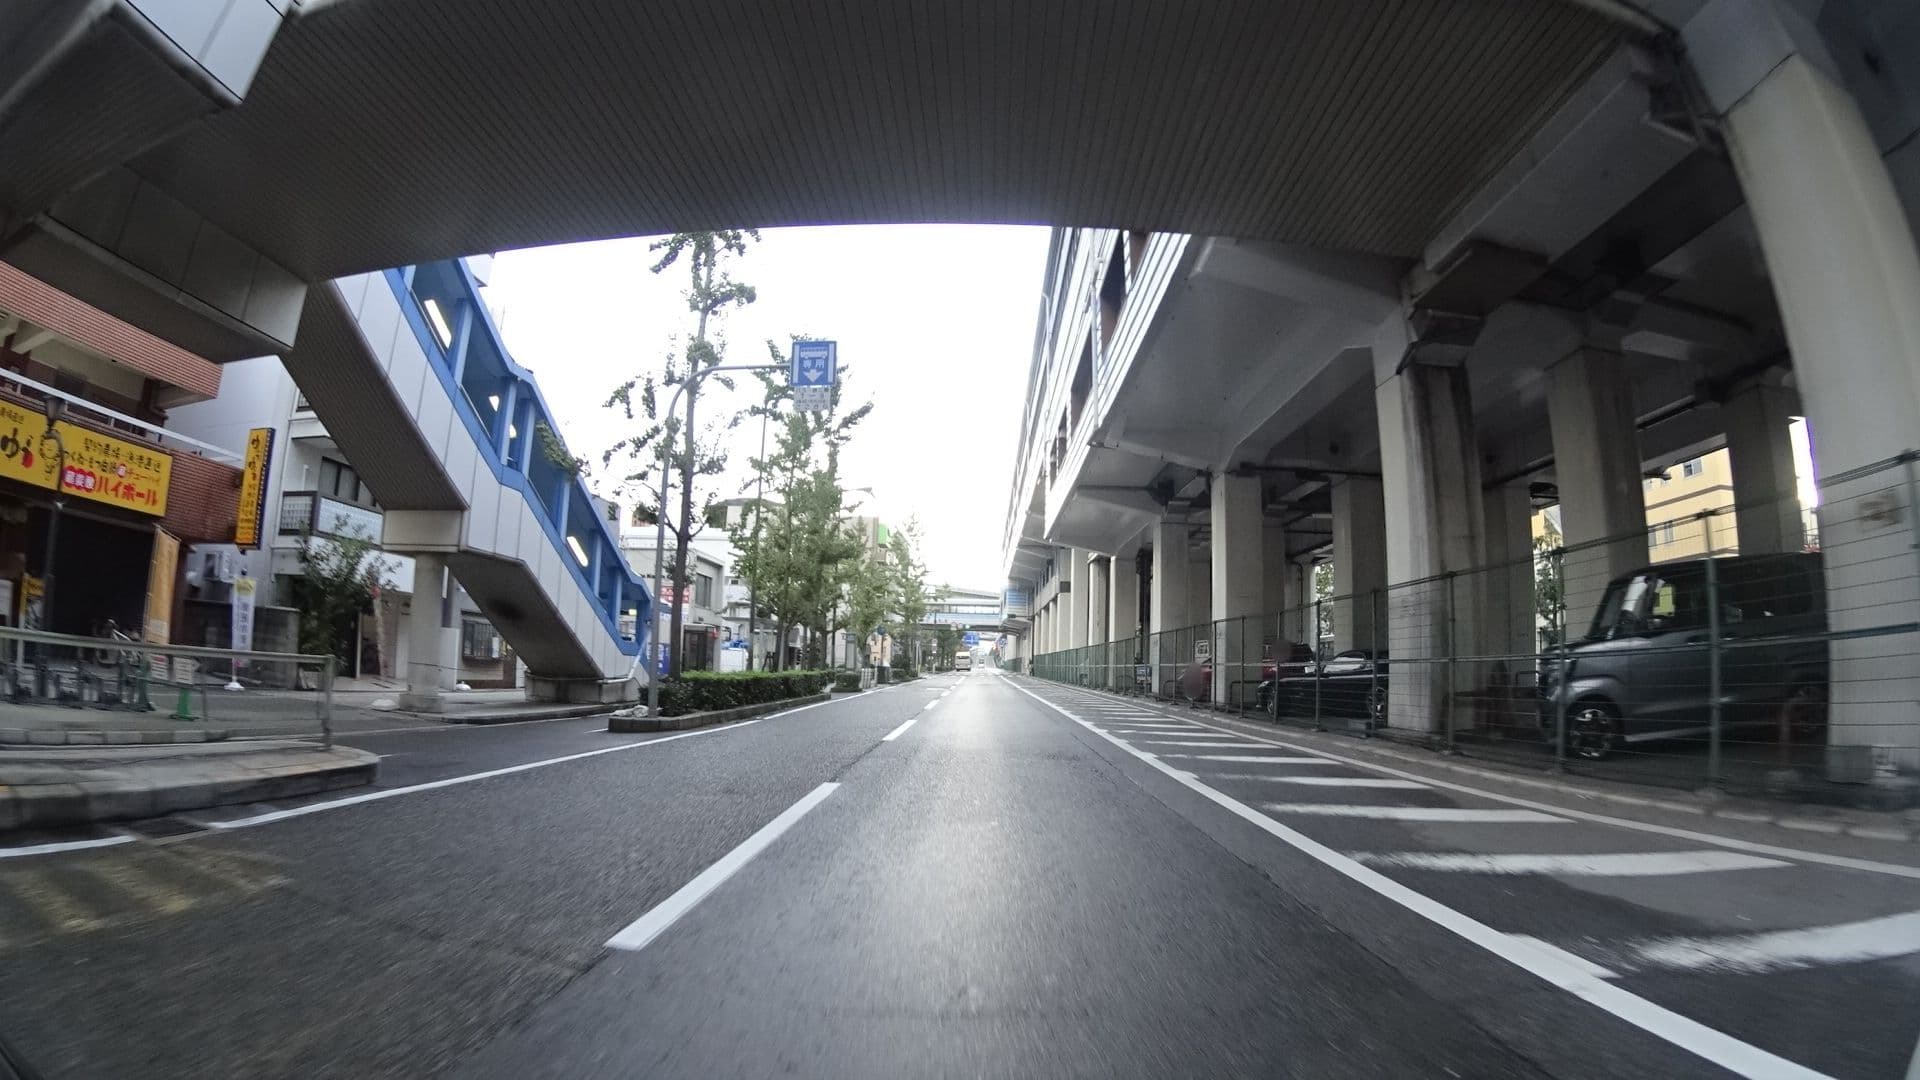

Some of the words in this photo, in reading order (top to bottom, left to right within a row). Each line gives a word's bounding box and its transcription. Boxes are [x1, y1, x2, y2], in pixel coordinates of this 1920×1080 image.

[96, 476, 157, 507] ハイボール
